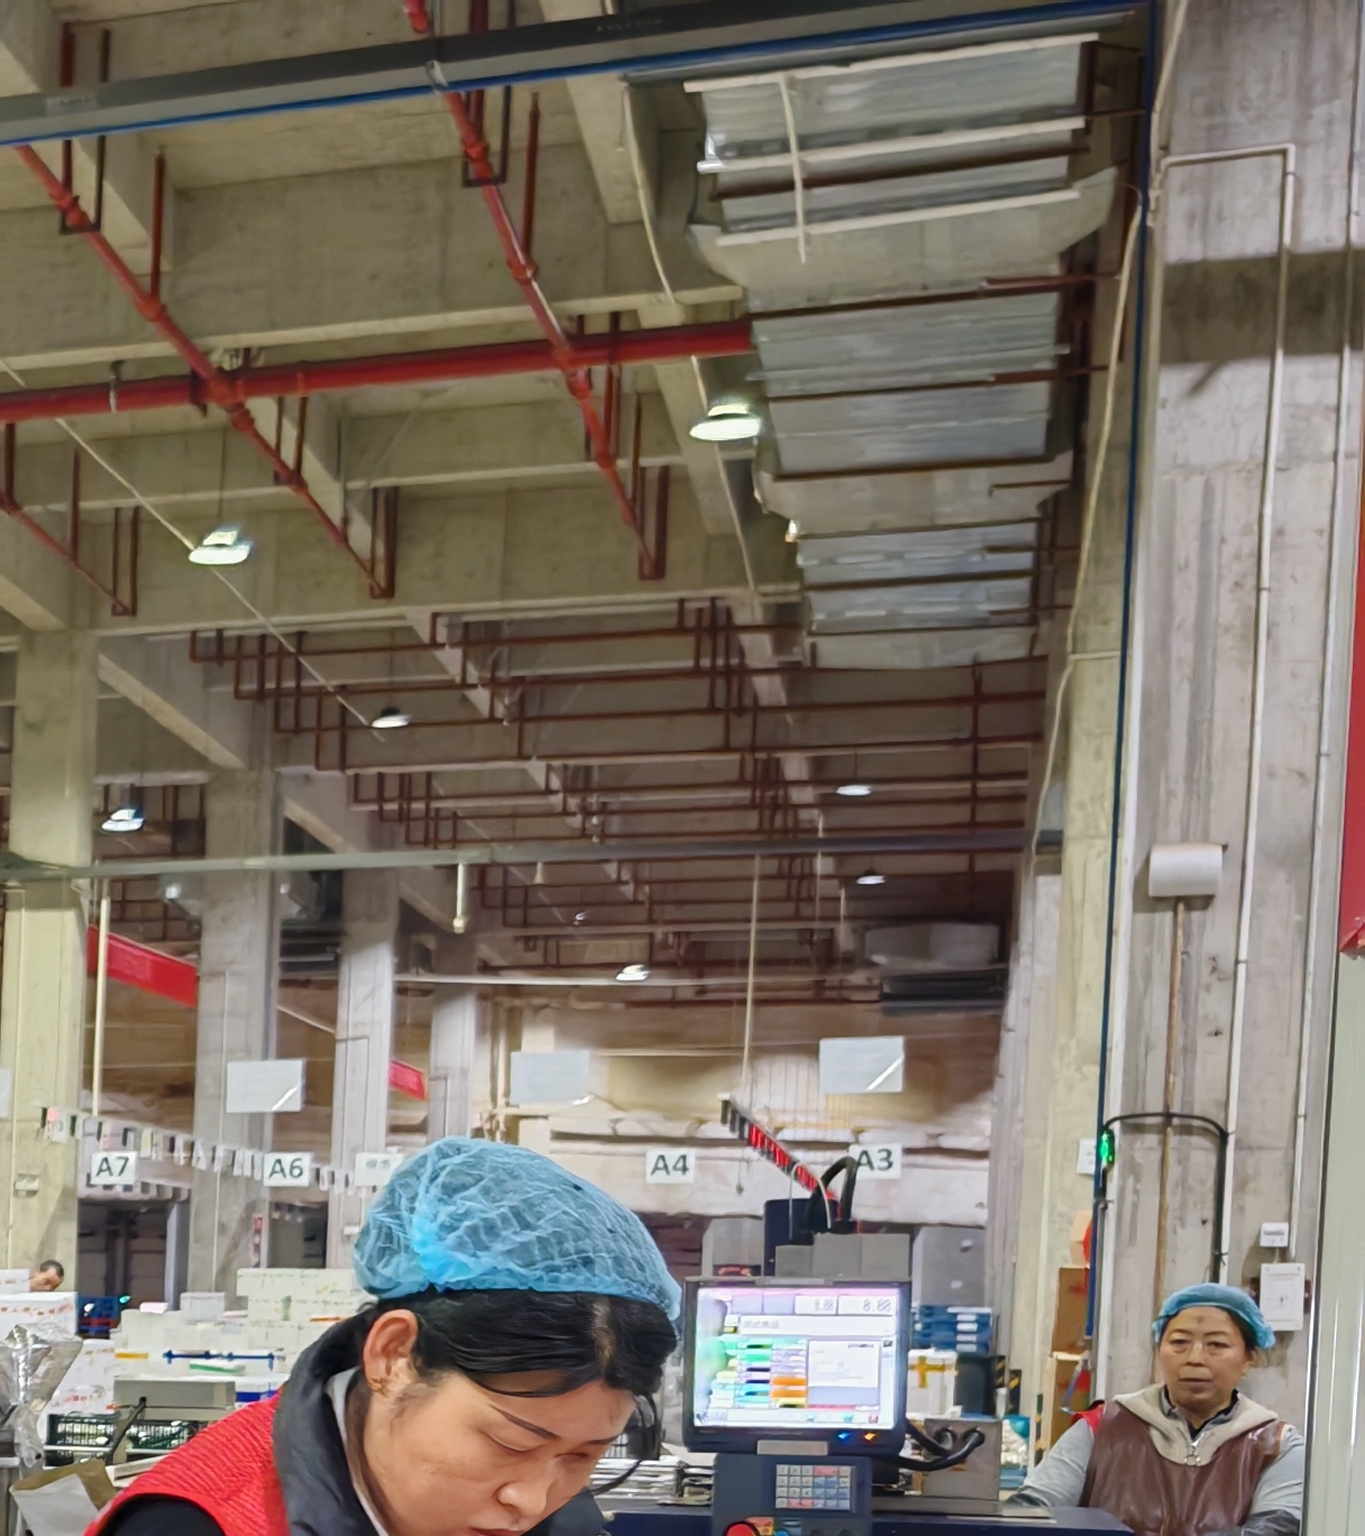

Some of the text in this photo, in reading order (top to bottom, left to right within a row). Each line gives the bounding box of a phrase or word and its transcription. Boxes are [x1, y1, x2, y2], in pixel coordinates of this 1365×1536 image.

[95, 1156, 129, 1177] A7
[268, 1157, 304, 1179] A6
[650, 1153, 690, 1176] A4
[856, 1147, 894, 1172] A3
